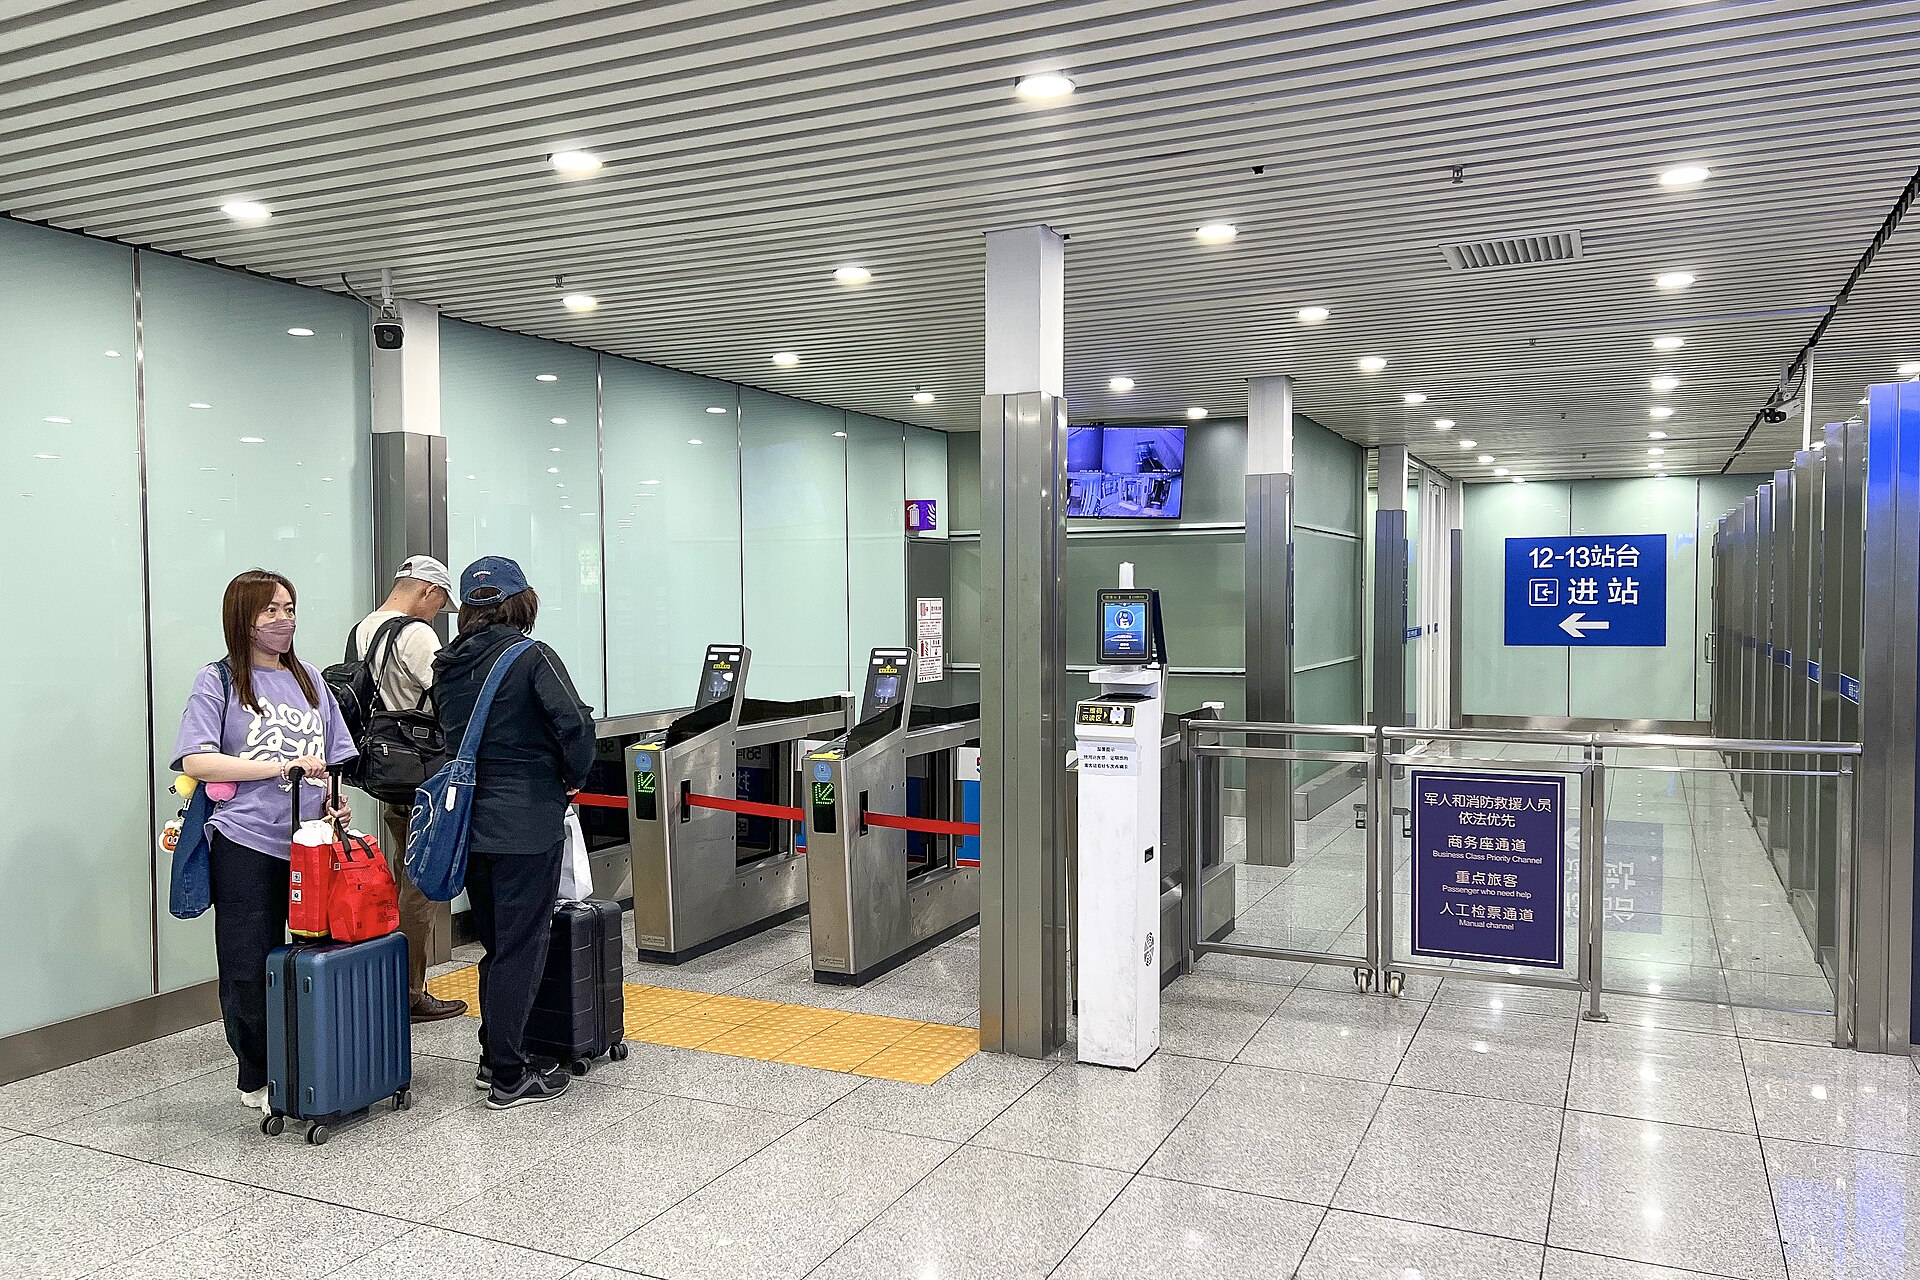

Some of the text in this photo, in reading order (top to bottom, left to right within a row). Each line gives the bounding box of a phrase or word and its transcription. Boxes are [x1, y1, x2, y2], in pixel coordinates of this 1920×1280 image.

[1529, 544, 1640, 569] 12-13站台
[1424, 792, 1552, 813] 军人和消防救援人员
[1458, 811, 1516, 828] 依法优先
[1447, 834, 1527, 853] 商务座通道
[1432, 850, 1543, 865] Business Class Priority Channel
[1455, 870, 1518, 887] 重点旅客
[1442, 884, 1532, 900] Passenger who need help
[1439, 901, 1534, 923] 人工检票通道
[1458, 918, 1515, 931] Manual channel
